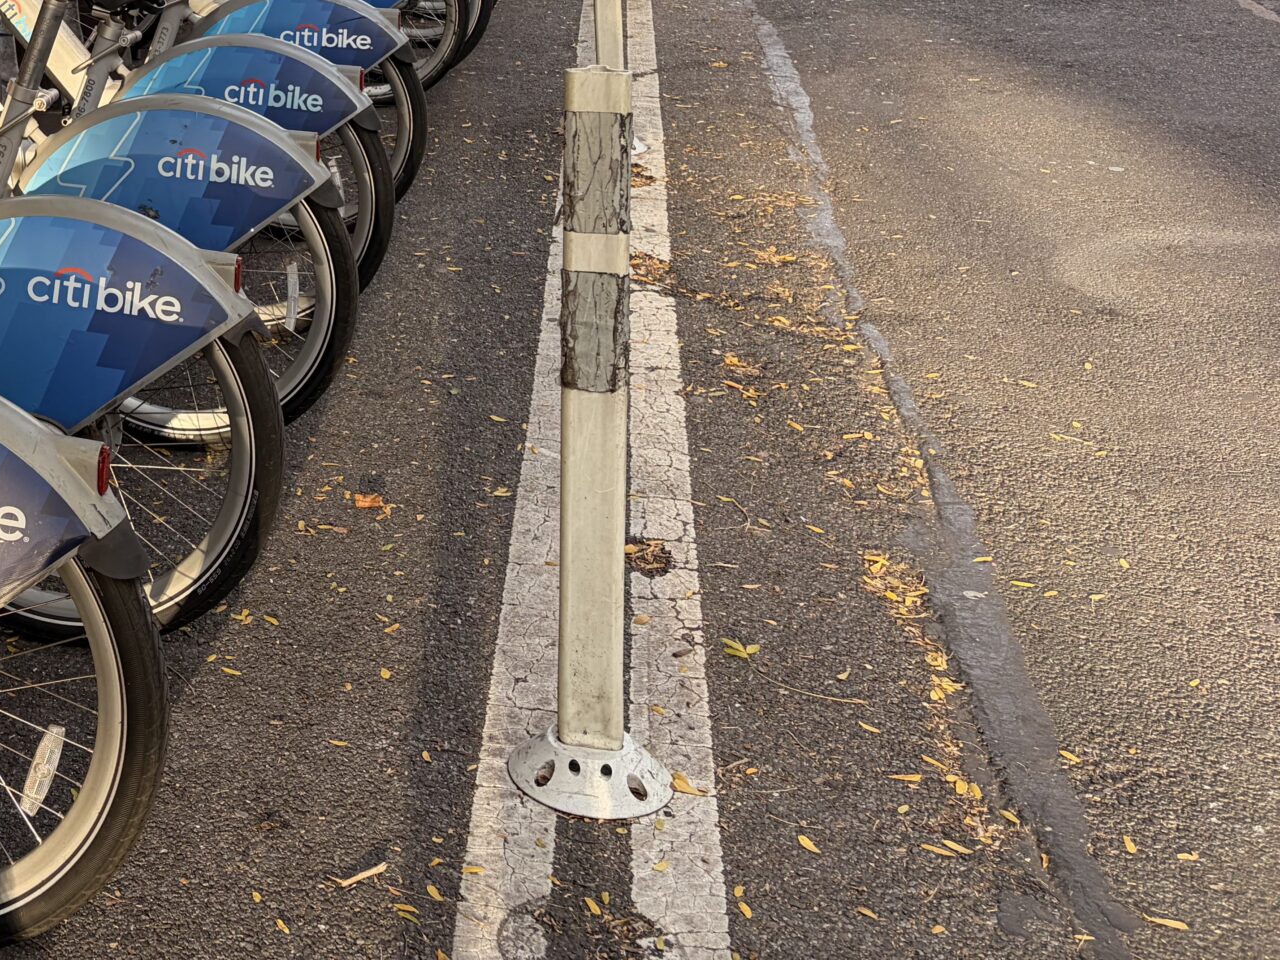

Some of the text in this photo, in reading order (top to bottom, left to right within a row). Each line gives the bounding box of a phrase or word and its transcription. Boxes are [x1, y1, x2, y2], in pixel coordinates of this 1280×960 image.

[322, 28, 371, 50] bike
[224, 81, 324, 113] citi bike
[157, 151, 274, 188] citi bike
[27, 271, 182, 322] citi bike
